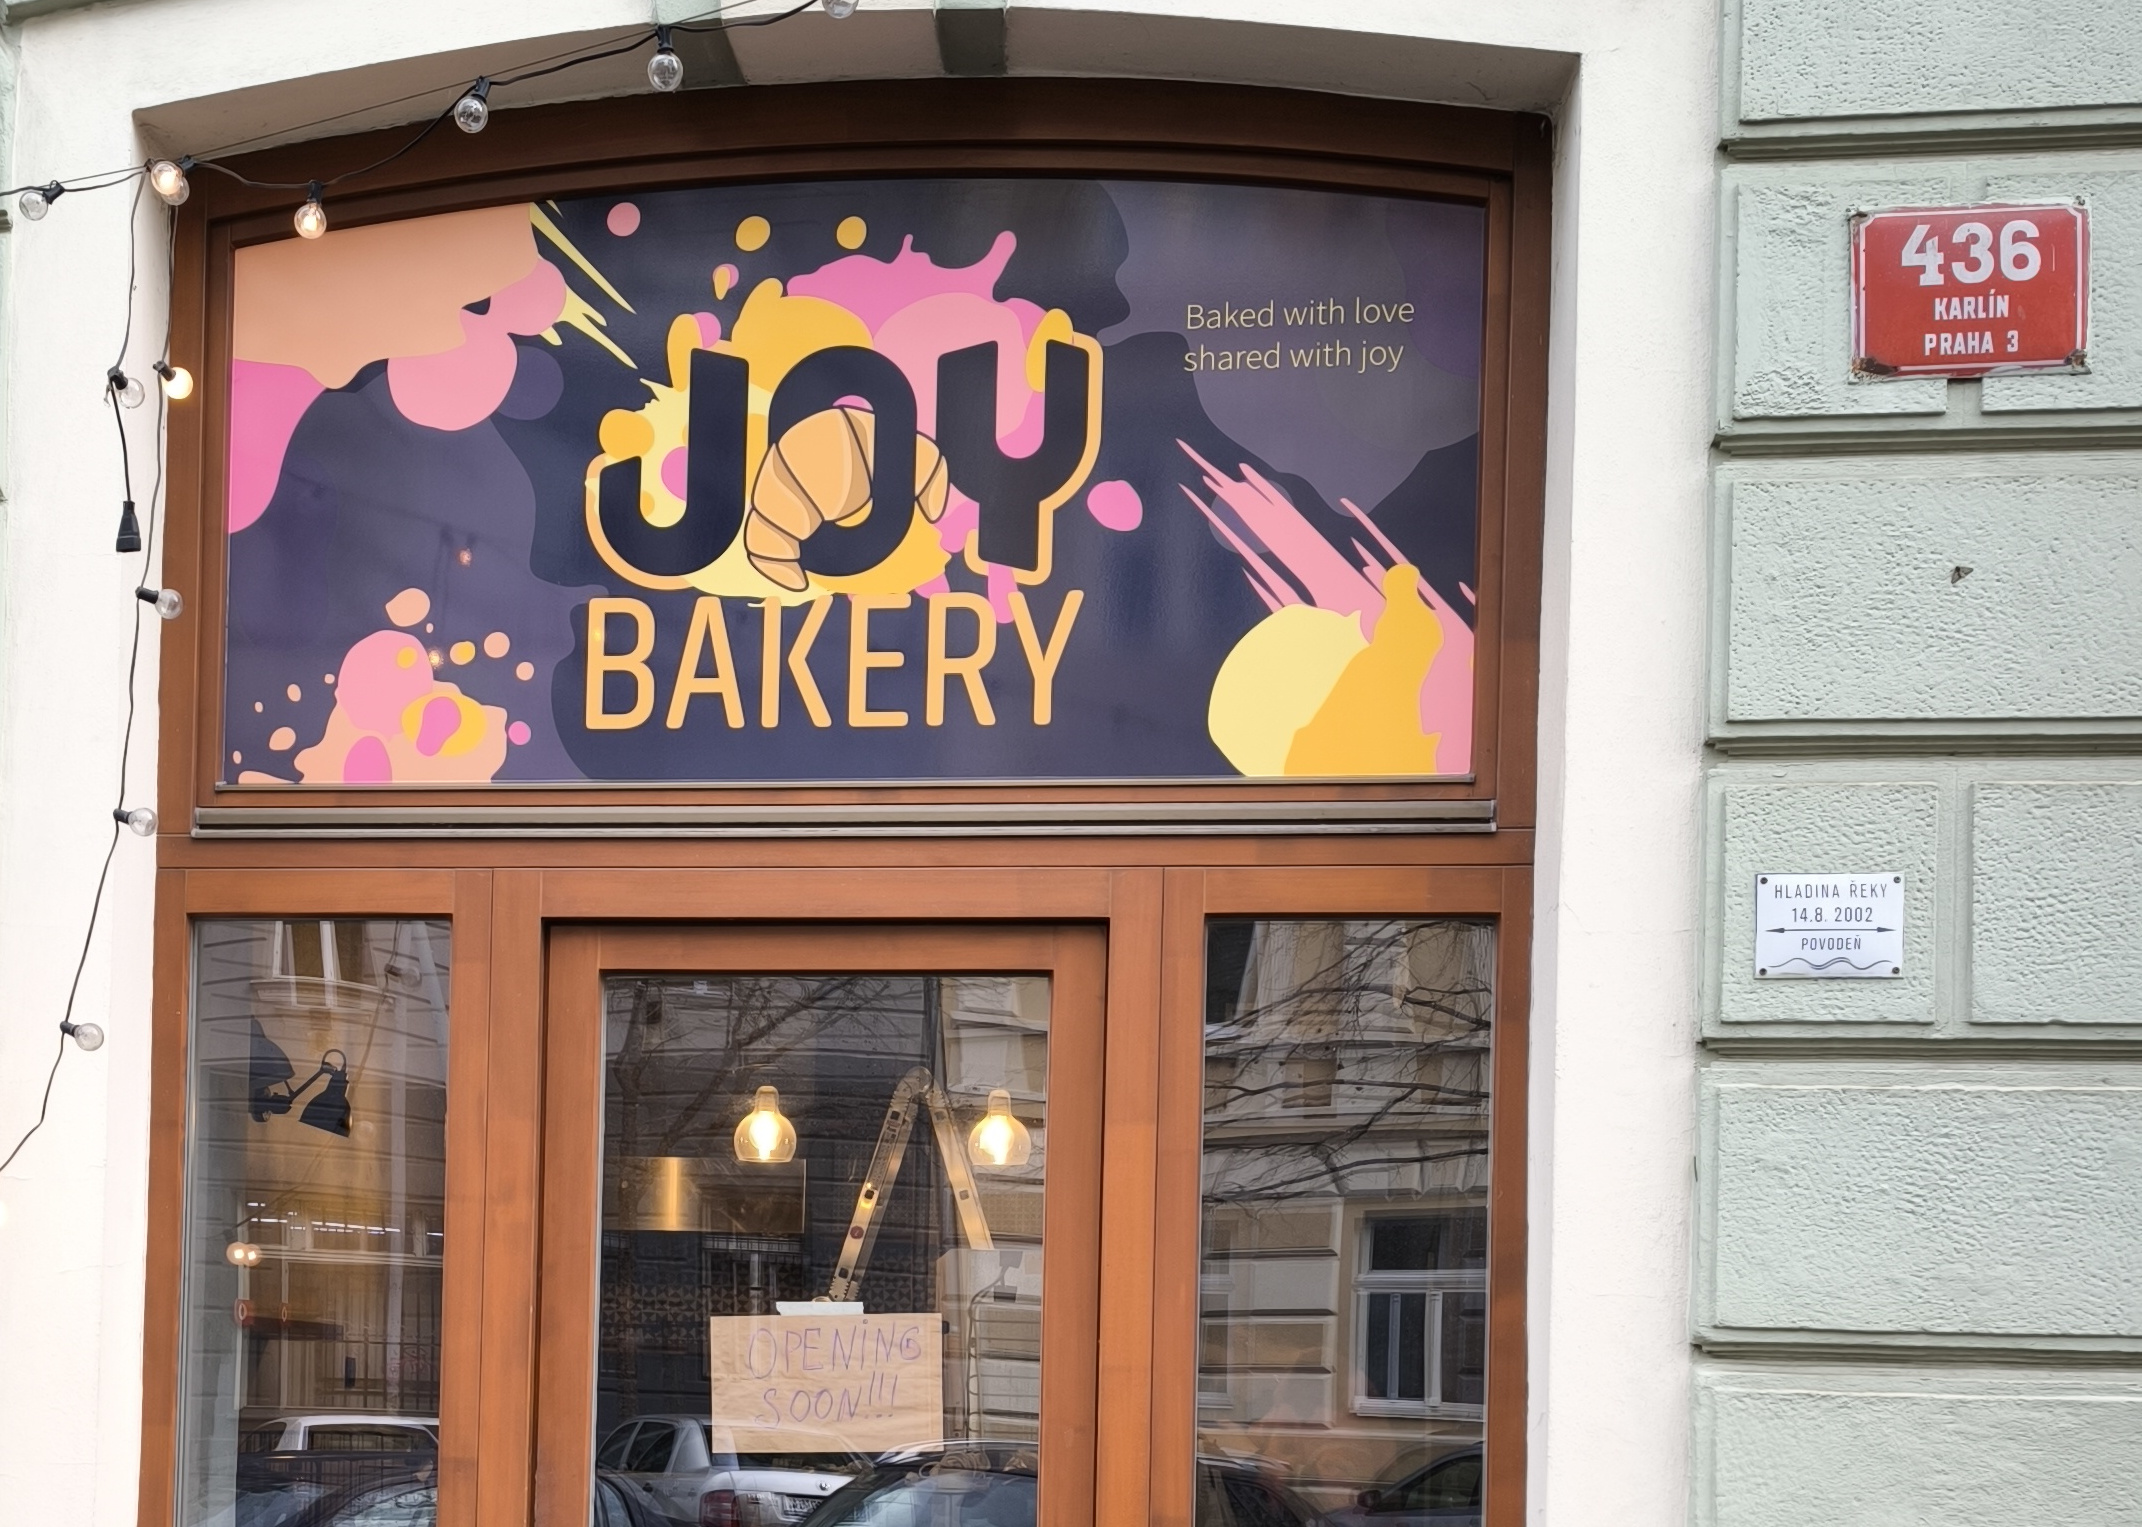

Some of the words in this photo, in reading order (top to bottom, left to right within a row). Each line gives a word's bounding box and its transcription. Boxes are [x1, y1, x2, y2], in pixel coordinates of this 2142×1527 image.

[1901, 219, 2041, 286] 436
[1186, 299, 1274, 330] Baked
[1283, 297, 1345, 326] with
[1355, 296, 1415, 324] love
[1934, 289, 2009, 320] KARLÍN
[1183, 341, 1281, 372] shared
[1290, 339, 1350, 368] with
[1357, 340, 1404, 374] joy
[1924, 331, 1994, 356] PRAHA
[2007, 330, 2019, 353] 3
[597, 338, 1092, 577] JOY
[585, 589, 1085, 730] BAKERY
[1774, 884, 1840, 899] HLADINA
[1849, 880, 1888, 898] ŘEKY
[1791, 907, 1828, 923] 14.8.
[1834, 906, 1873, 923] 2002
[1801, 934, 1862, 951] POVODEŇ
[754, 1371, 898, 1429] SOON!!!
